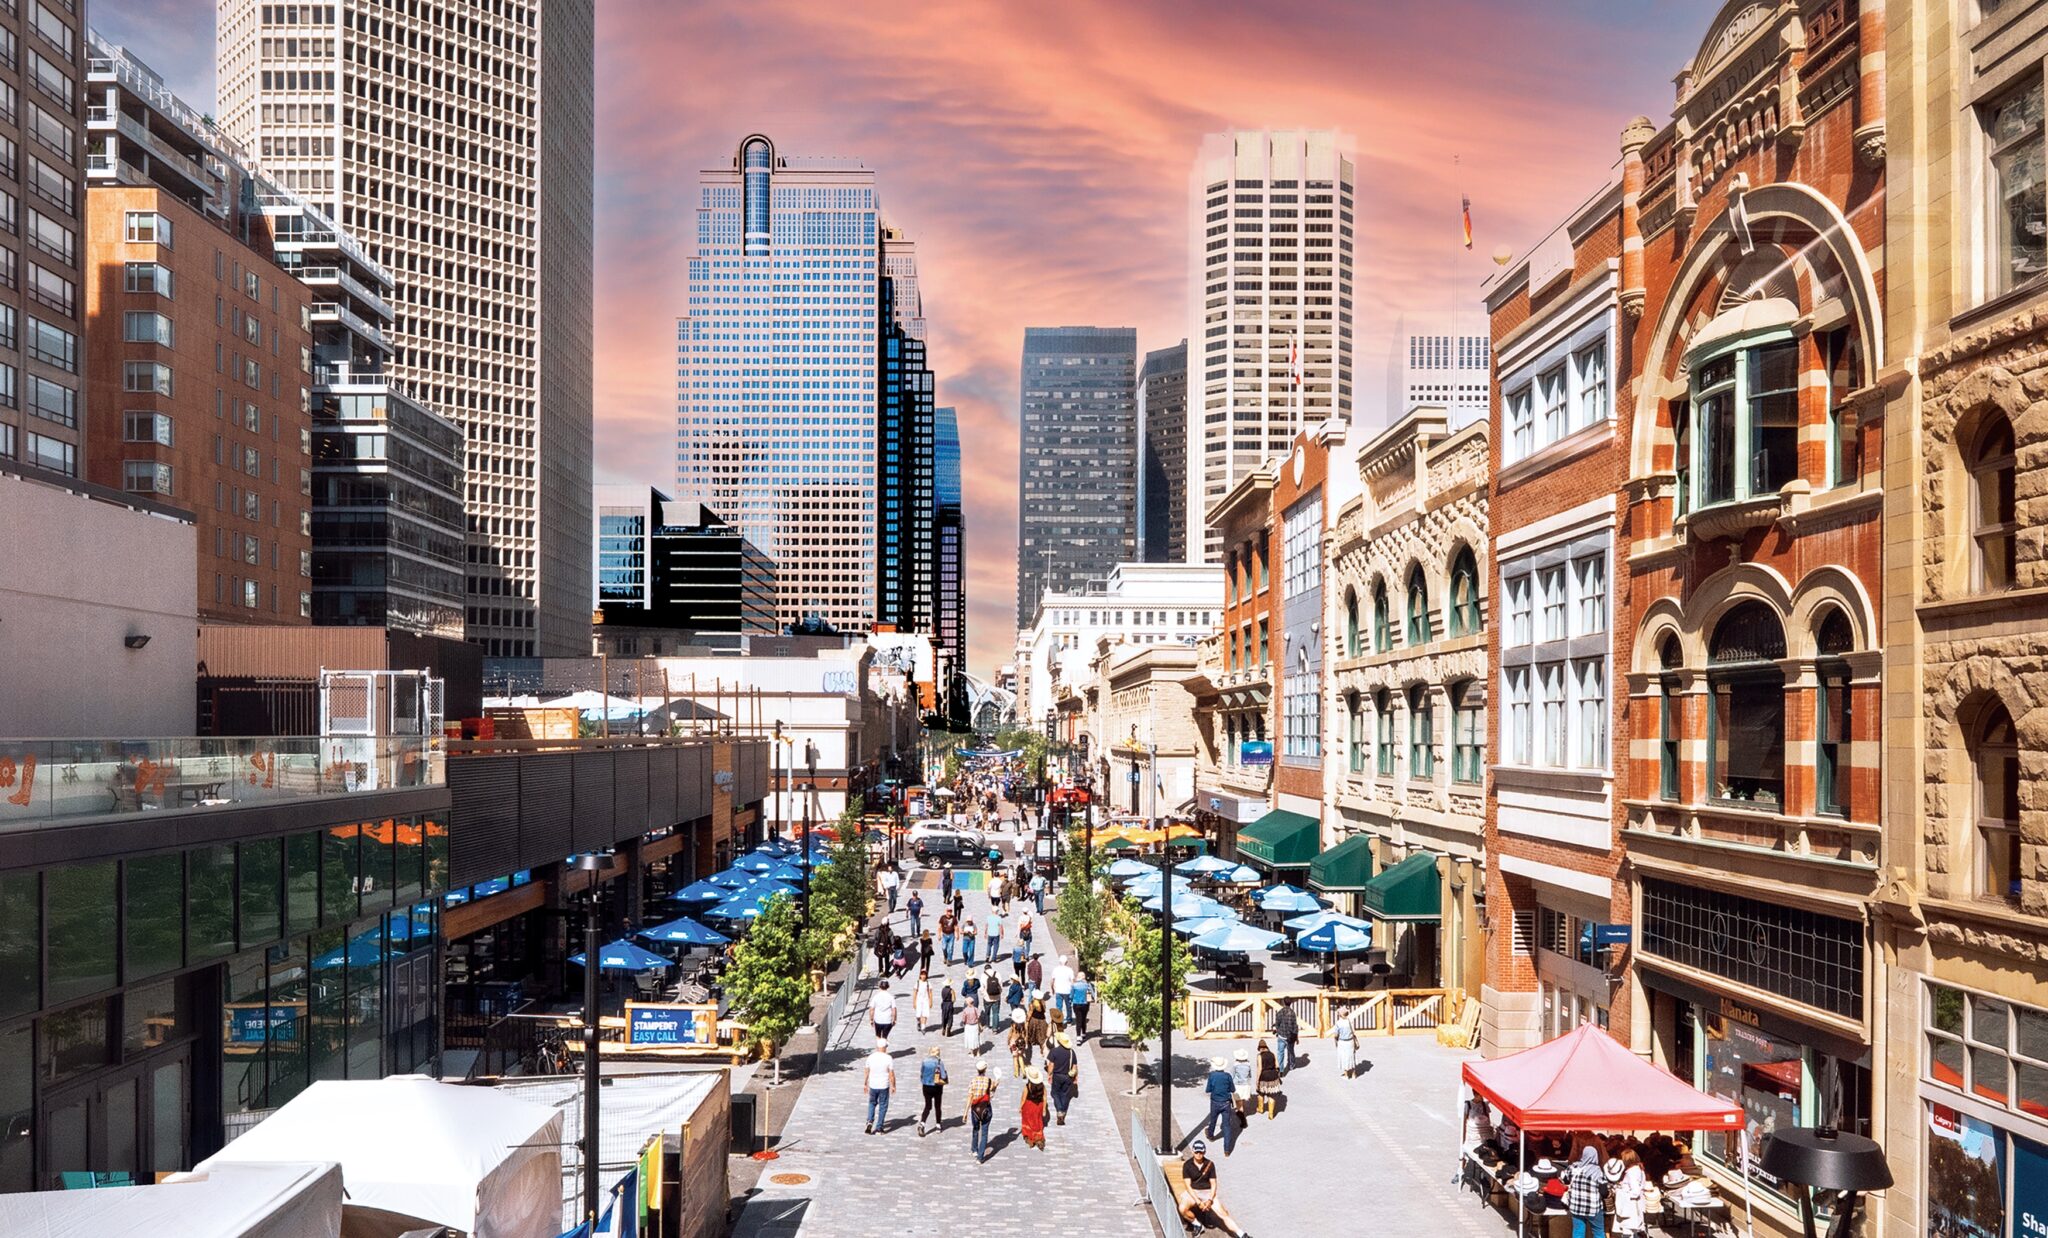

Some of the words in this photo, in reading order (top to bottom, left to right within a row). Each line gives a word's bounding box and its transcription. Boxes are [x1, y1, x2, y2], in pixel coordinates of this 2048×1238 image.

[1721, 998, 1760, 1027] Kanata
[634, 1021, 678, 1031] STAMPEDE?
[634, 1031, 656, 1041] EASY
[656, 1031, 677, 1041] CALL
[1934, 1114, 1952, 1128] Calgary
[2022, 1211, 2048, 1238] Sha
